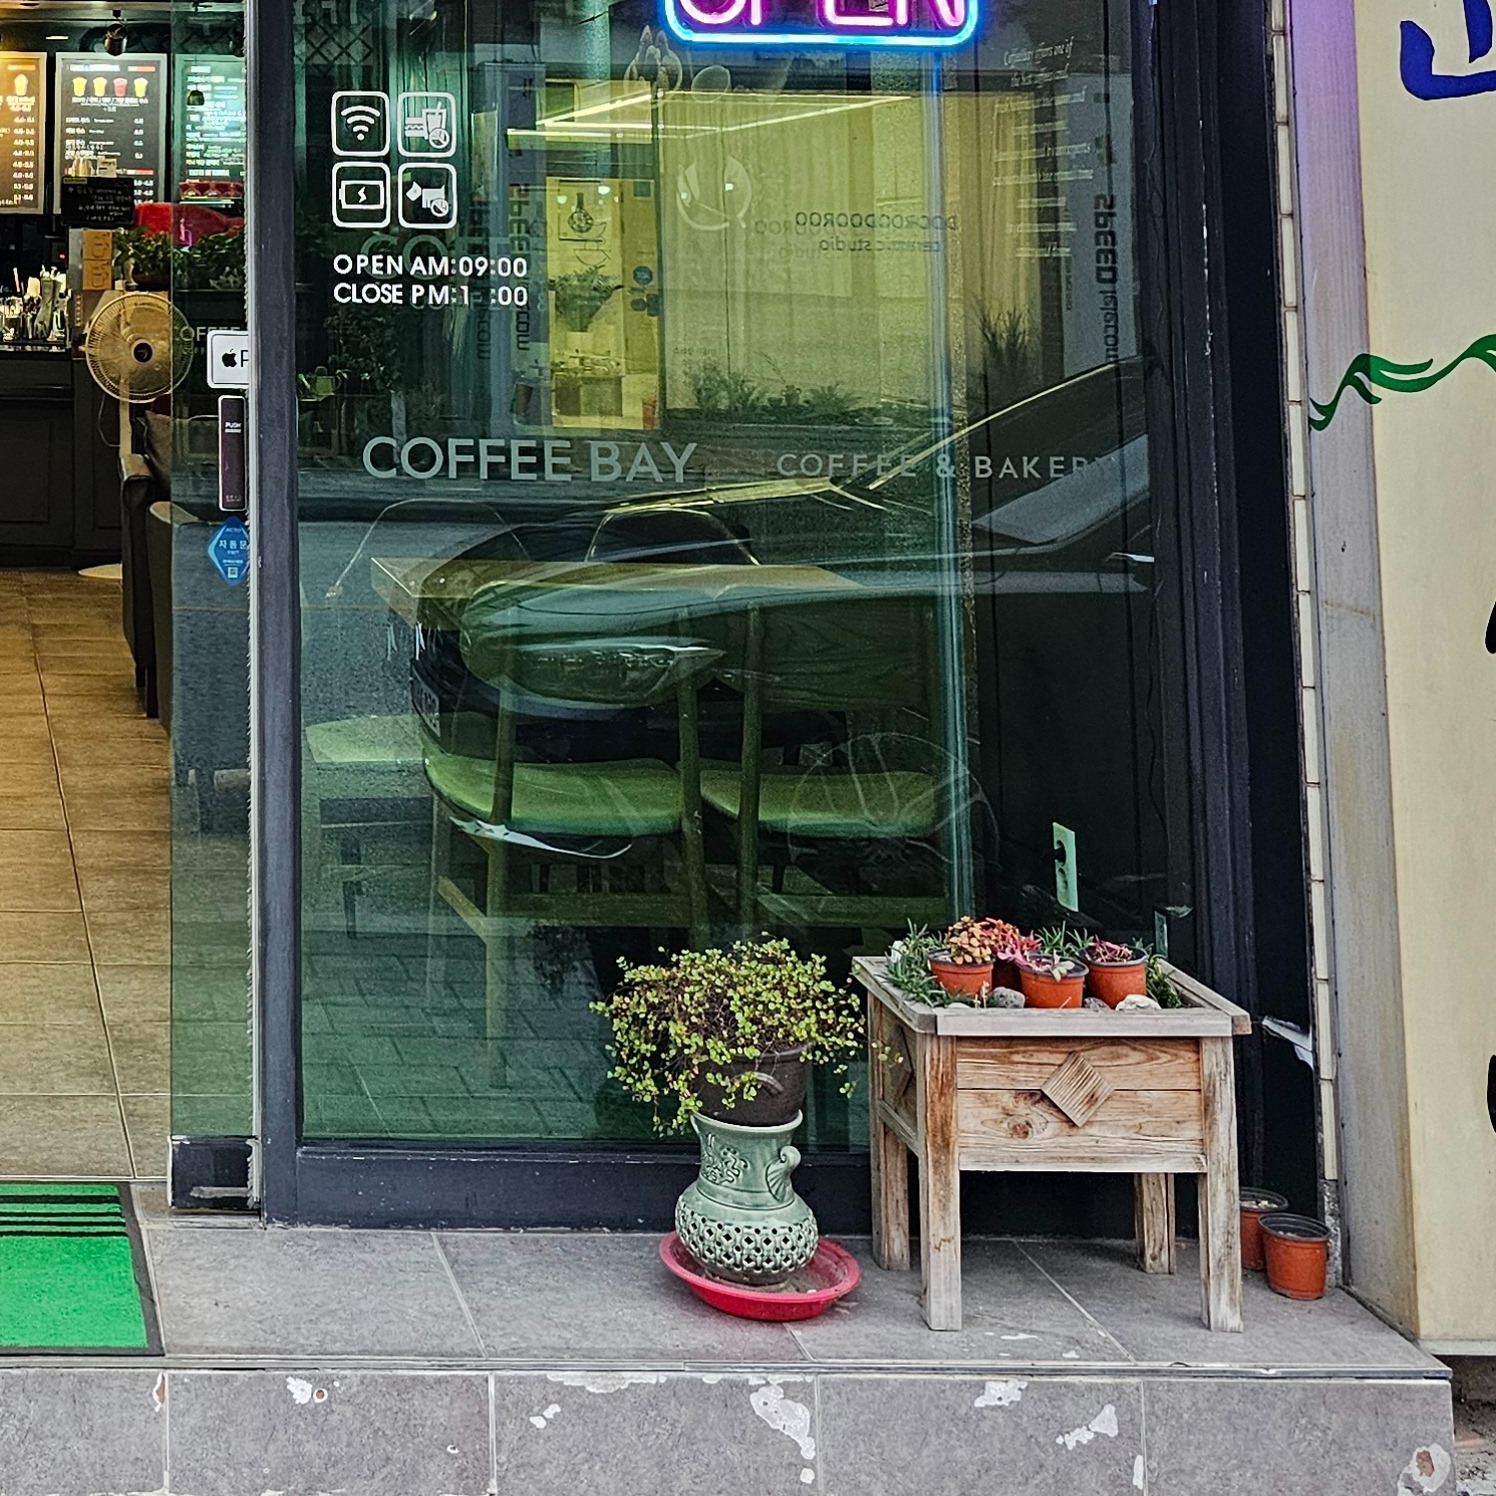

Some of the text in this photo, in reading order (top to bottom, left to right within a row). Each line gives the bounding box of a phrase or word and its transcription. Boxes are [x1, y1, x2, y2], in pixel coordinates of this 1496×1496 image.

[333, 254, 528, 277] OPEN AM:09:00
[333, 282, 403, 305] CLOSE
[362, 436, 698, 484] COFFEE BAY
[776, 453, 917, 478] COFFEE
